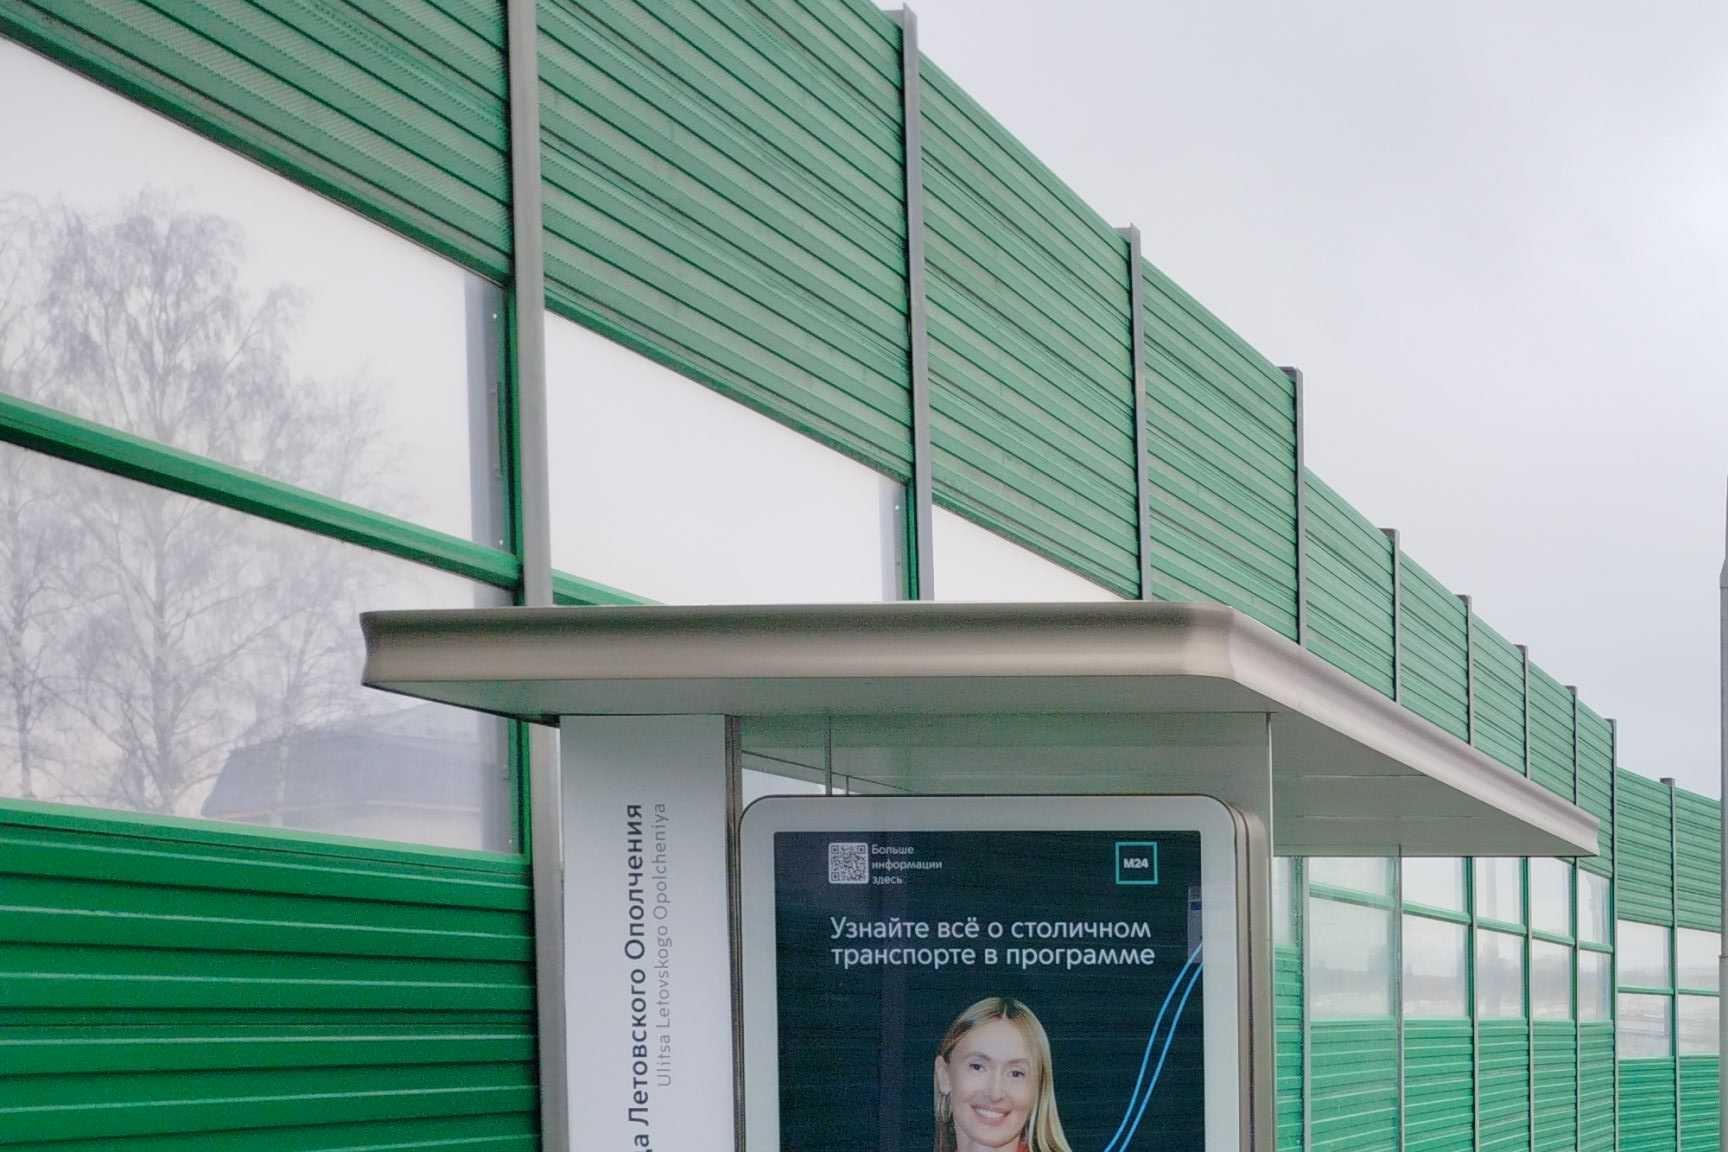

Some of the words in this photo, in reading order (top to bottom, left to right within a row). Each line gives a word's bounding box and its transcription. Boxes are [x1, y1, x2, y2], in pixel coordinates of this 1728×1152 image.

[651, 803, 671, 921] Opolcheniya
[871, 844, 914, 855] Больше
[871, 858, 943, 871] информации
[624, 804, 646, 960] Ополчения
[872, 875, 904, 886] здесь
[830, 916, 930, 940] Узнайте
[937, 917, 980, 939] всё
[987, 921, 1004, 939] о
[1010, 920, 1152, 939] столичном
[653, 925, 672, 1029] Letovskogo
[831, 948, 977, 970] транспорте
[984, 948, 999, 965] в
[1006, 948, 1156, 970] программе
[628, 968, 649, 1126] Летовского
[655, 1034, 672, 1087] Ulitsa
